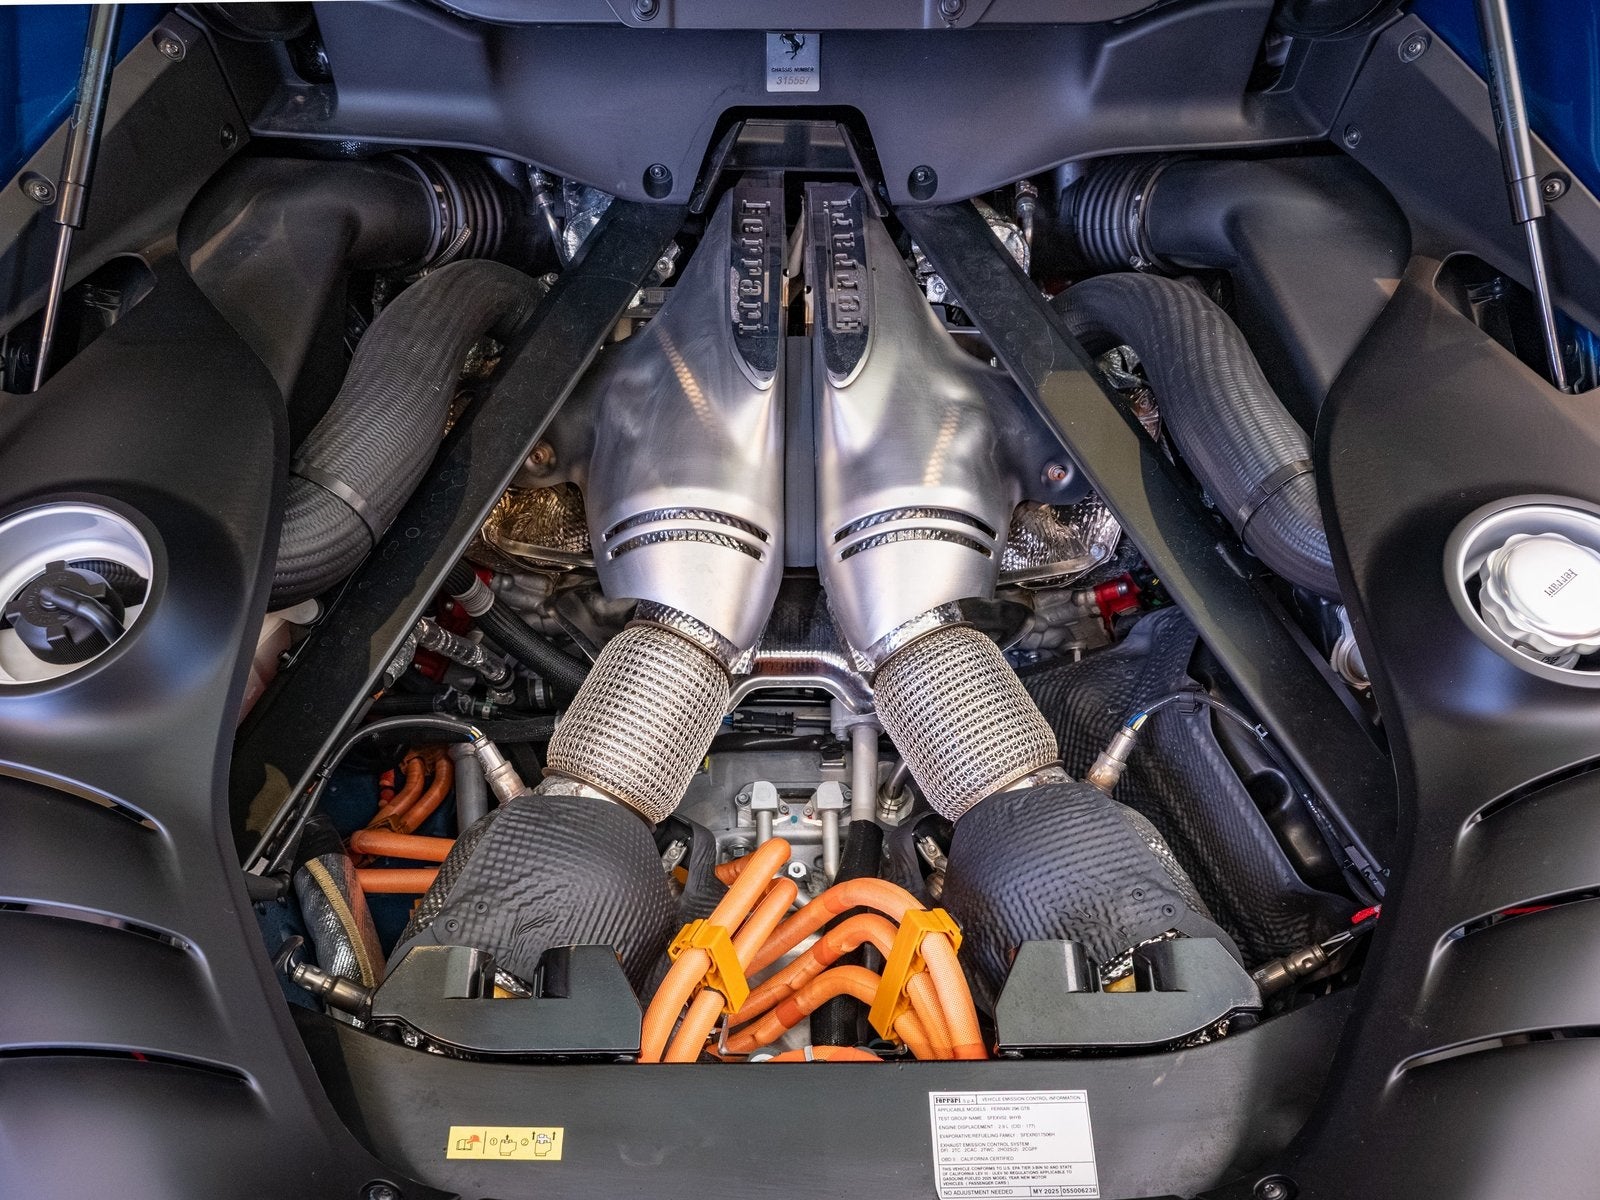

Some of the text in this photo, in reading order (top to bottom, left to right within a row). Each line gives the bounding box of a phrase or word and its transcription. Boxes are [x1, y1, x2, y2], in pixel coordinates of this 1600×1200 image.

[738, 199, 771, 335] Ferrari
[822, 198, 863, 334] Ferrari
[1544, 568, 1578, 598] Ferrari
